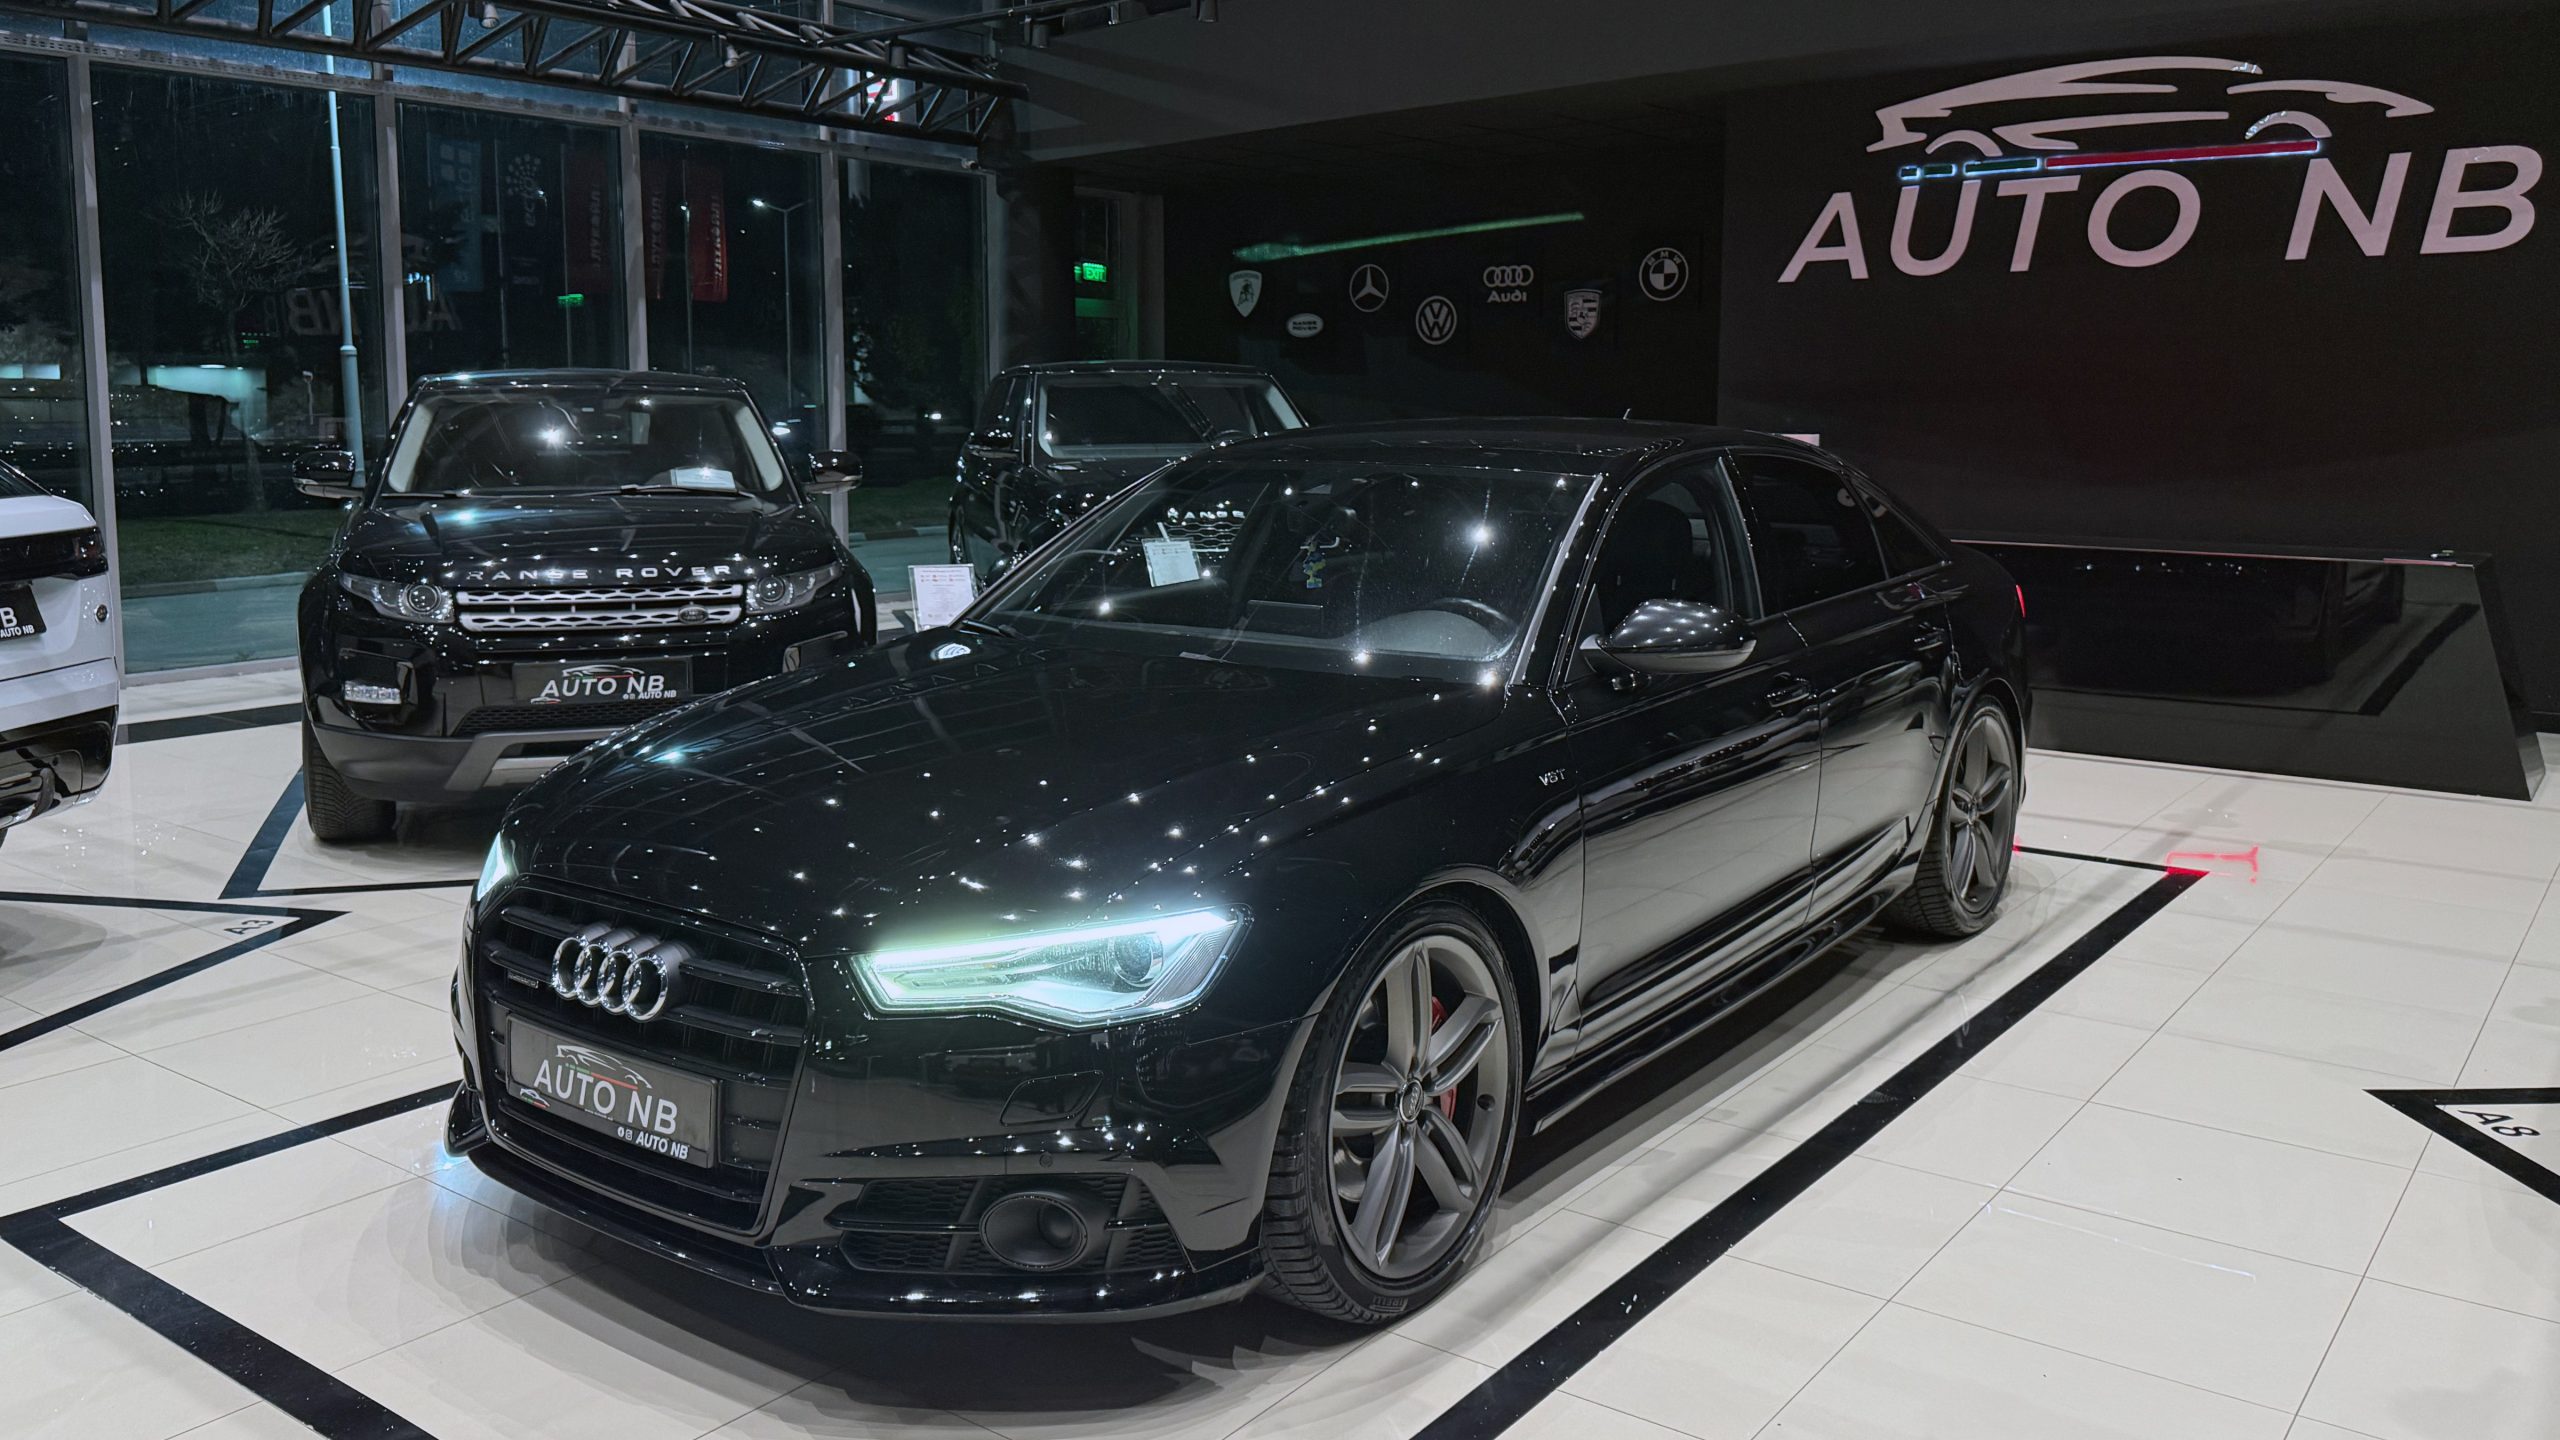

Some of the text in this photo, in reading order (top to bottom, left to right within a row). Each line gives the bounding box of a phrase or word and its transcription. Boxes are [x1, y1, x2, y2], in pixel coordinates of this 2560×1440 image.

[1777, 144, 2543, 283] AUTO NB
[1085, 267, 1105, 280] EXIT
[1487, 289, 1527, 304] Audi
[466, 564, 732, 581] RANGE ROVER
[0, 607, 18, 628] B
[0, 624, 35, 639] AUTO NB
[540, 675, 664, 697] AUTO NB
[638, 689, 677, 700] AUTO NB
[224, 920, 274, 935] A3
[533, 1059, 678, 1135] AUTO NB
[2457, 1110, 2541, 1137] A8
[636, 1132, 689, 1161] AUTO NB
